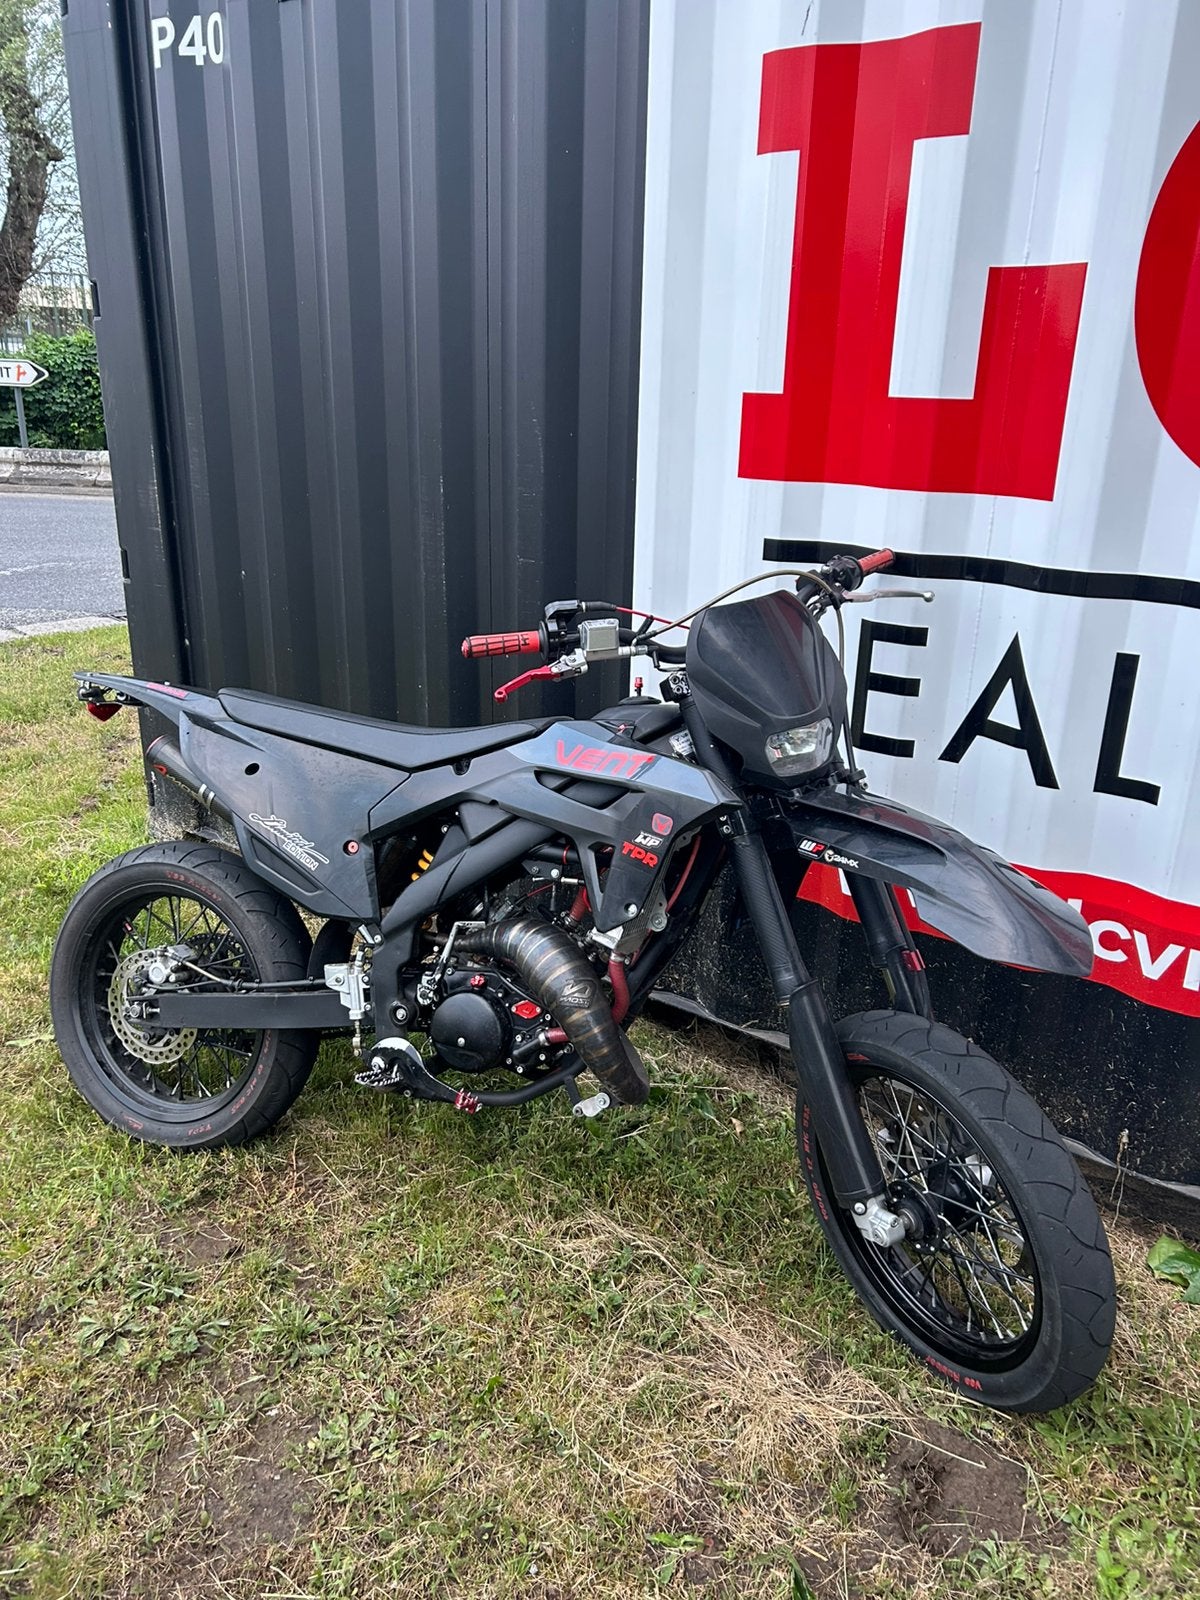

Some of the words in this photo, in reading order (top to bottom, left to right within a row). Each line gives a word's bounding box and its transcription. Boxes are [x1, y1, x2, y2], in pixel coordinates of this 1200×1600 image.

[151, 11, 224, 69] P40
[556, 739, 657, 777] VENT
[283, 840, 319, 871] EDITION
[622, 841, 658, 868] TPR
